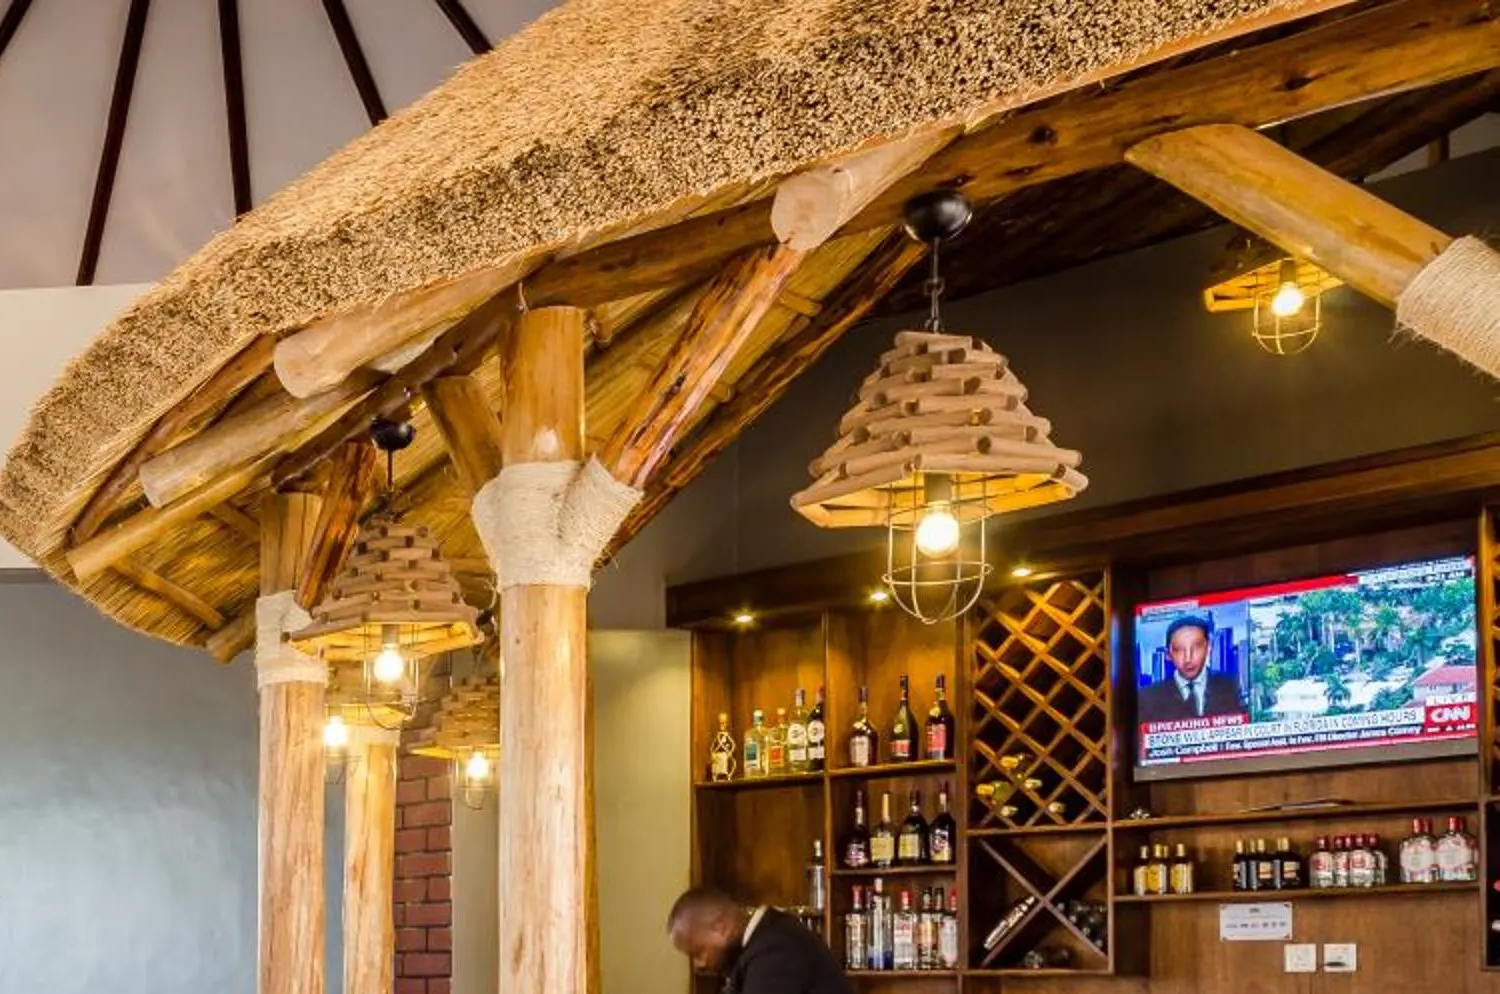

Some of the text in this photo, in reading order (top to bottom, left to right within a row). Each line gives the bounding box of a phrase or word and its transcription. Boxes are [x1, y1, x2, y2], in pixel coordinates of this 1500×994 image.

[1431, 705, 1471, 723] CNN
[1149, 732, 1181, 748] STONE
[1183, 730, 1205, 744] WILL
[1207, 726, 1242, 741] APPEAR
[1254, 721, 1282, 736] COURT
[1293, 717, 1329, 734] FLORIDA
[1341, 712, 1378, 729] COMING
[1381, 709, 1417, 725] HOURS
[1150, 714, 1244, 733] BREAKING NEWS
[1149, 747, 1174, 758] Josh
[1176, 743, 1218, 756] Campbell
